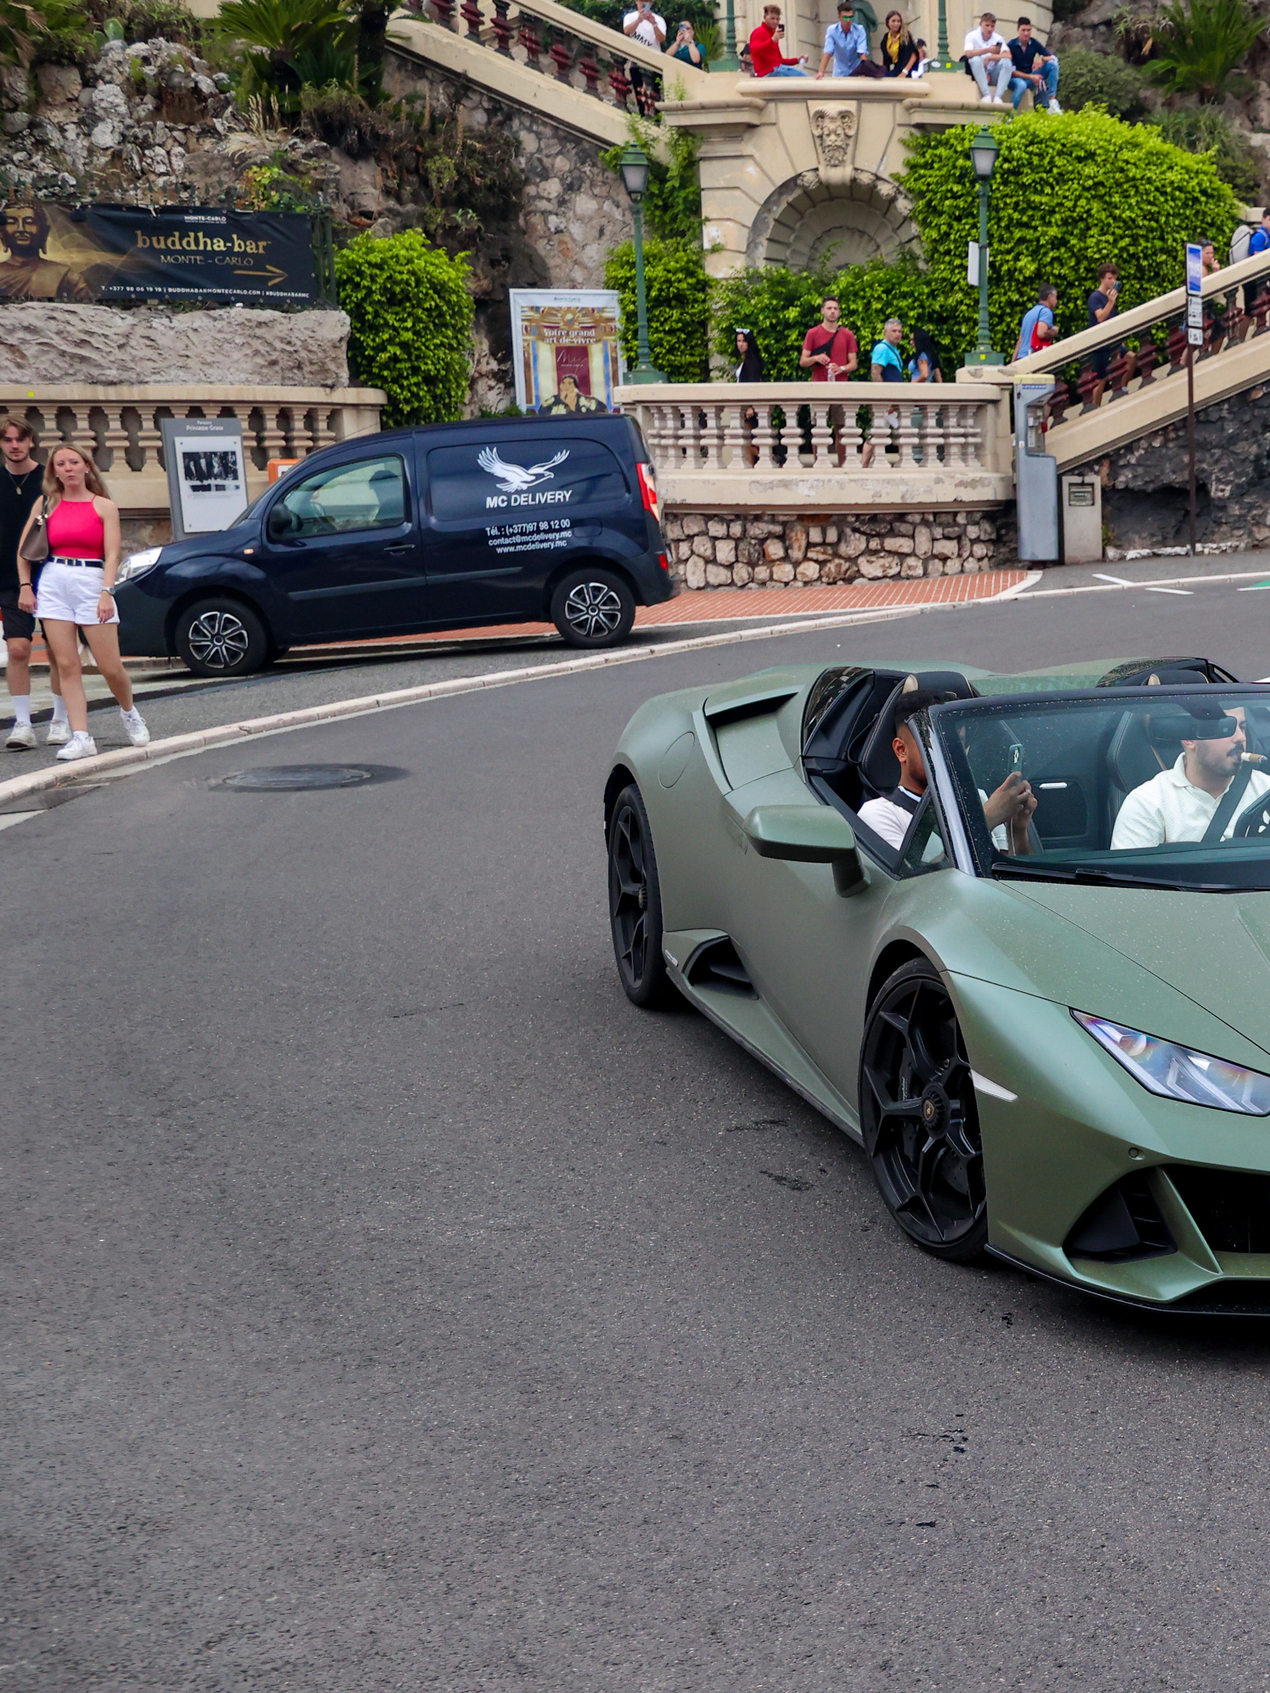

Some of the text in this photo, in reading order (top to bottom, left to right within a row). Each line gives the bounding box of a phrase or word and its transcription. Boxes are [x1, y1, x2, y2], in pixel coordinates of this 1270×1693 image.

[135, 230, 267, 255] buddha-bar
[160, 254, 205, 265] MONTE
[215, 256, 254, 267] CARLO
[543, 328, 596, 339] Votre grand
[544, 336, 557, 344] art
[486, 489, 572, 508] MC DELIVERY
[485, 526, 500, 537] Tél.
[539, 521, 549, 531] 98
[550, 520, 559, 529] 12
[560, 518, 571, 528] 00
[488, 530, 572, 547] contact@mcdelivery.mc
[496, 540, 567, 554] www.mcdelivery.mc
